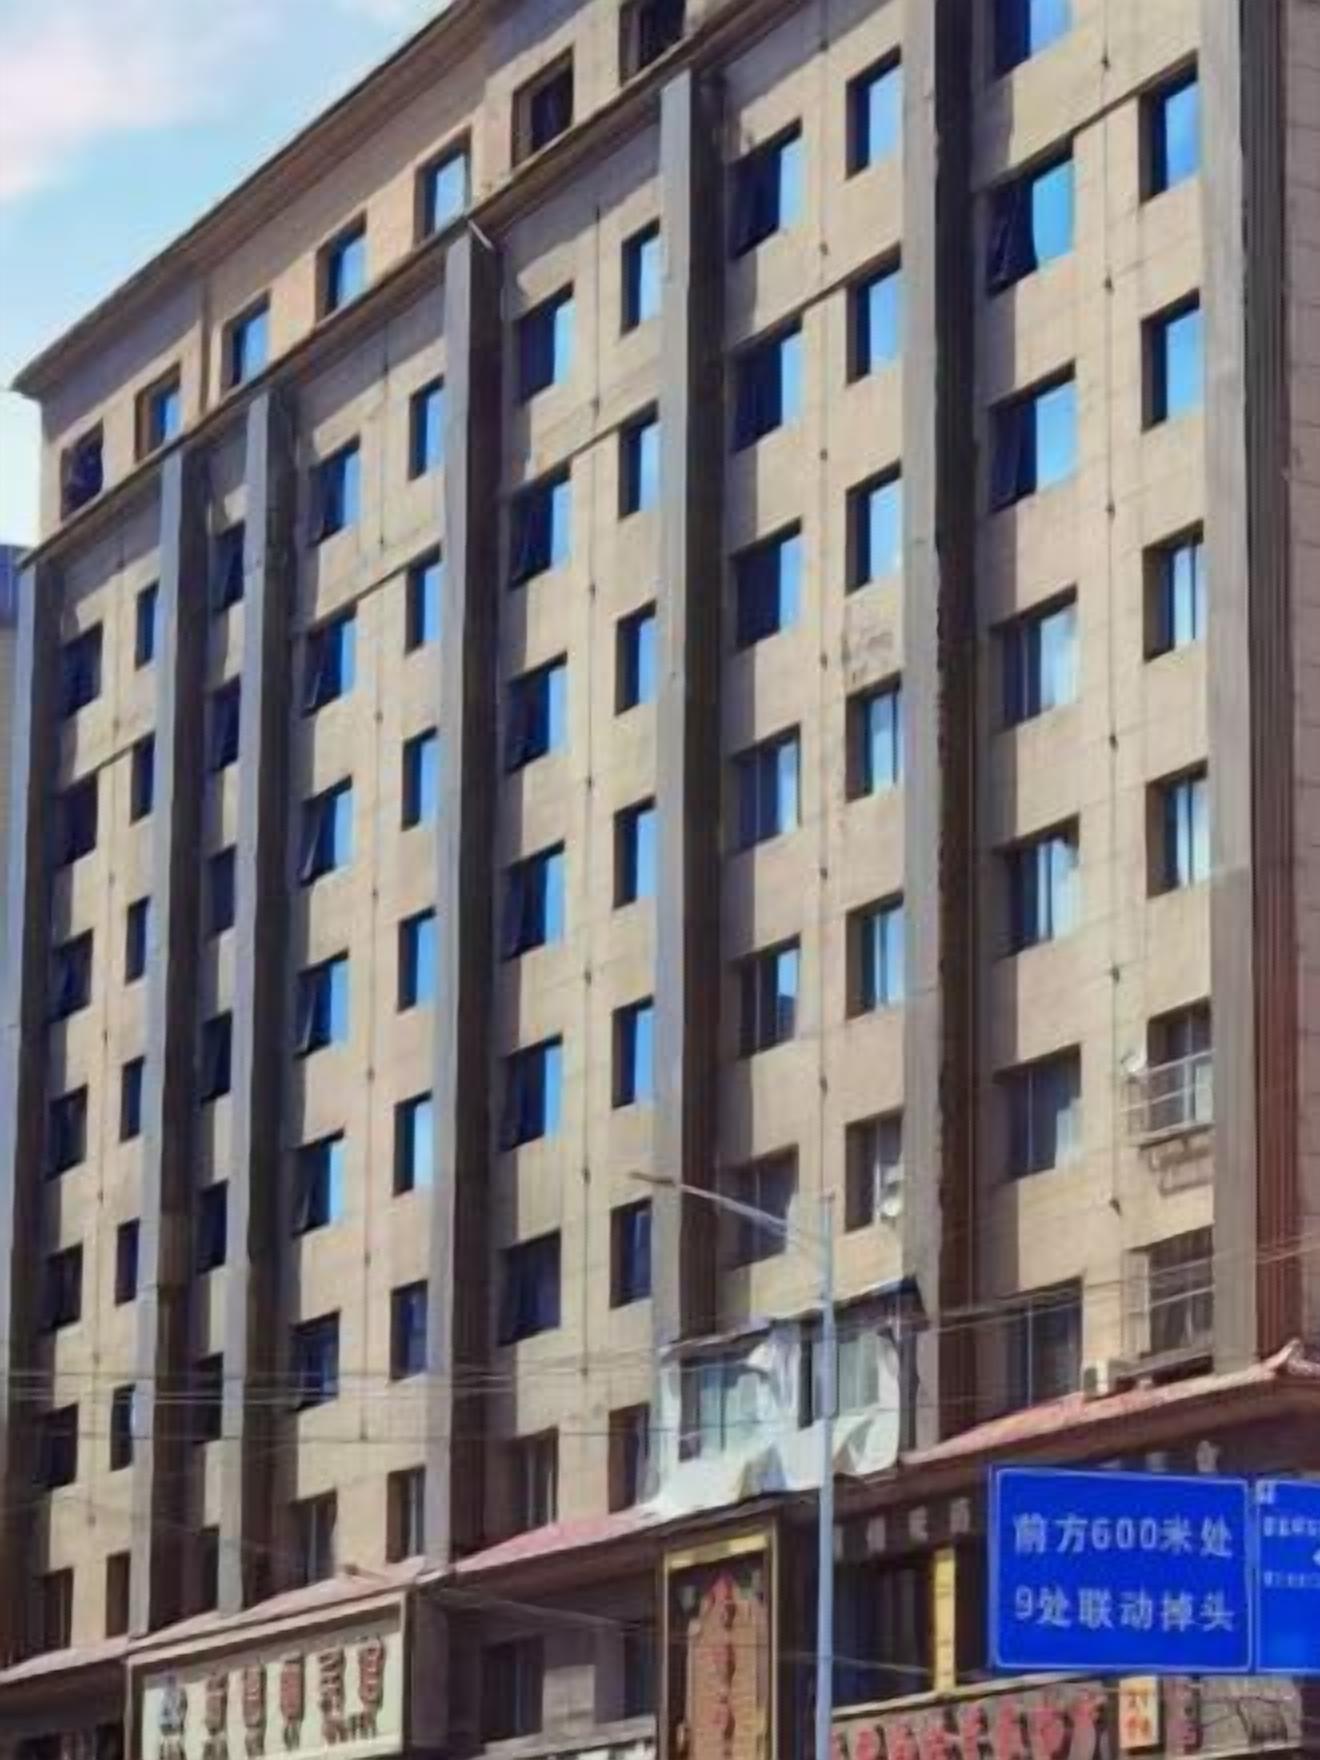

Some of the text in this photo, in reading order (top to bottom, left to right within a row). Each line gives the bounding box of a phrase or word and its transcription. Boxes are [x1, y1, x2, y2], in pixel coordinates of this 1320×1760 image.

[1012, 1512, 1234, 1560] 前方600米处
[1013, 1585, 1236, 1633] 9处联动掉头
